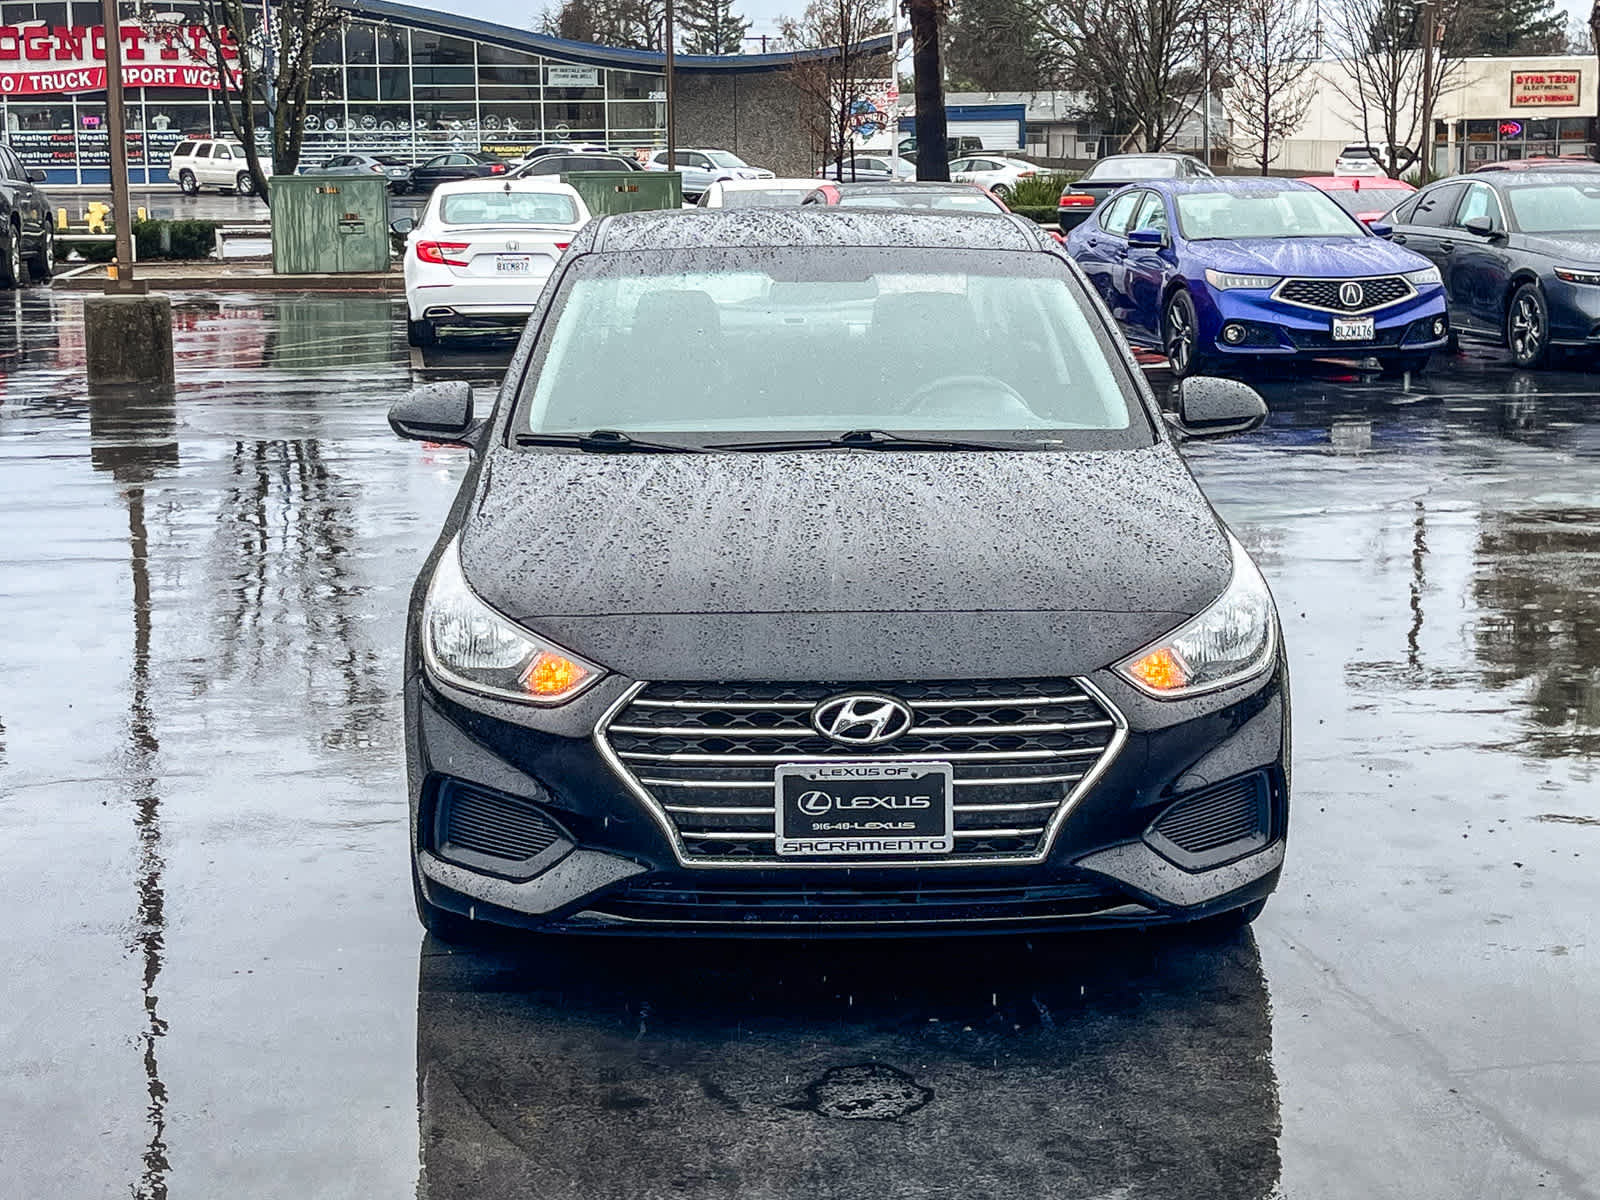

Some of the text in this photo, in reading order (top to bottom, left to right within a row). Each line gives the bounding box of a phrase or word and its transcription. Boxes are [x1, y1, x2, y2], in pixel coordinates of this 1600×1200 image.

[29, 71, 92, 91] TRUCK
[819, 768, 909, 777] LEXUS OF
[835, 796, 931, 809] LEXUS
[783, 840, 946, 852] SACRAMENTO
